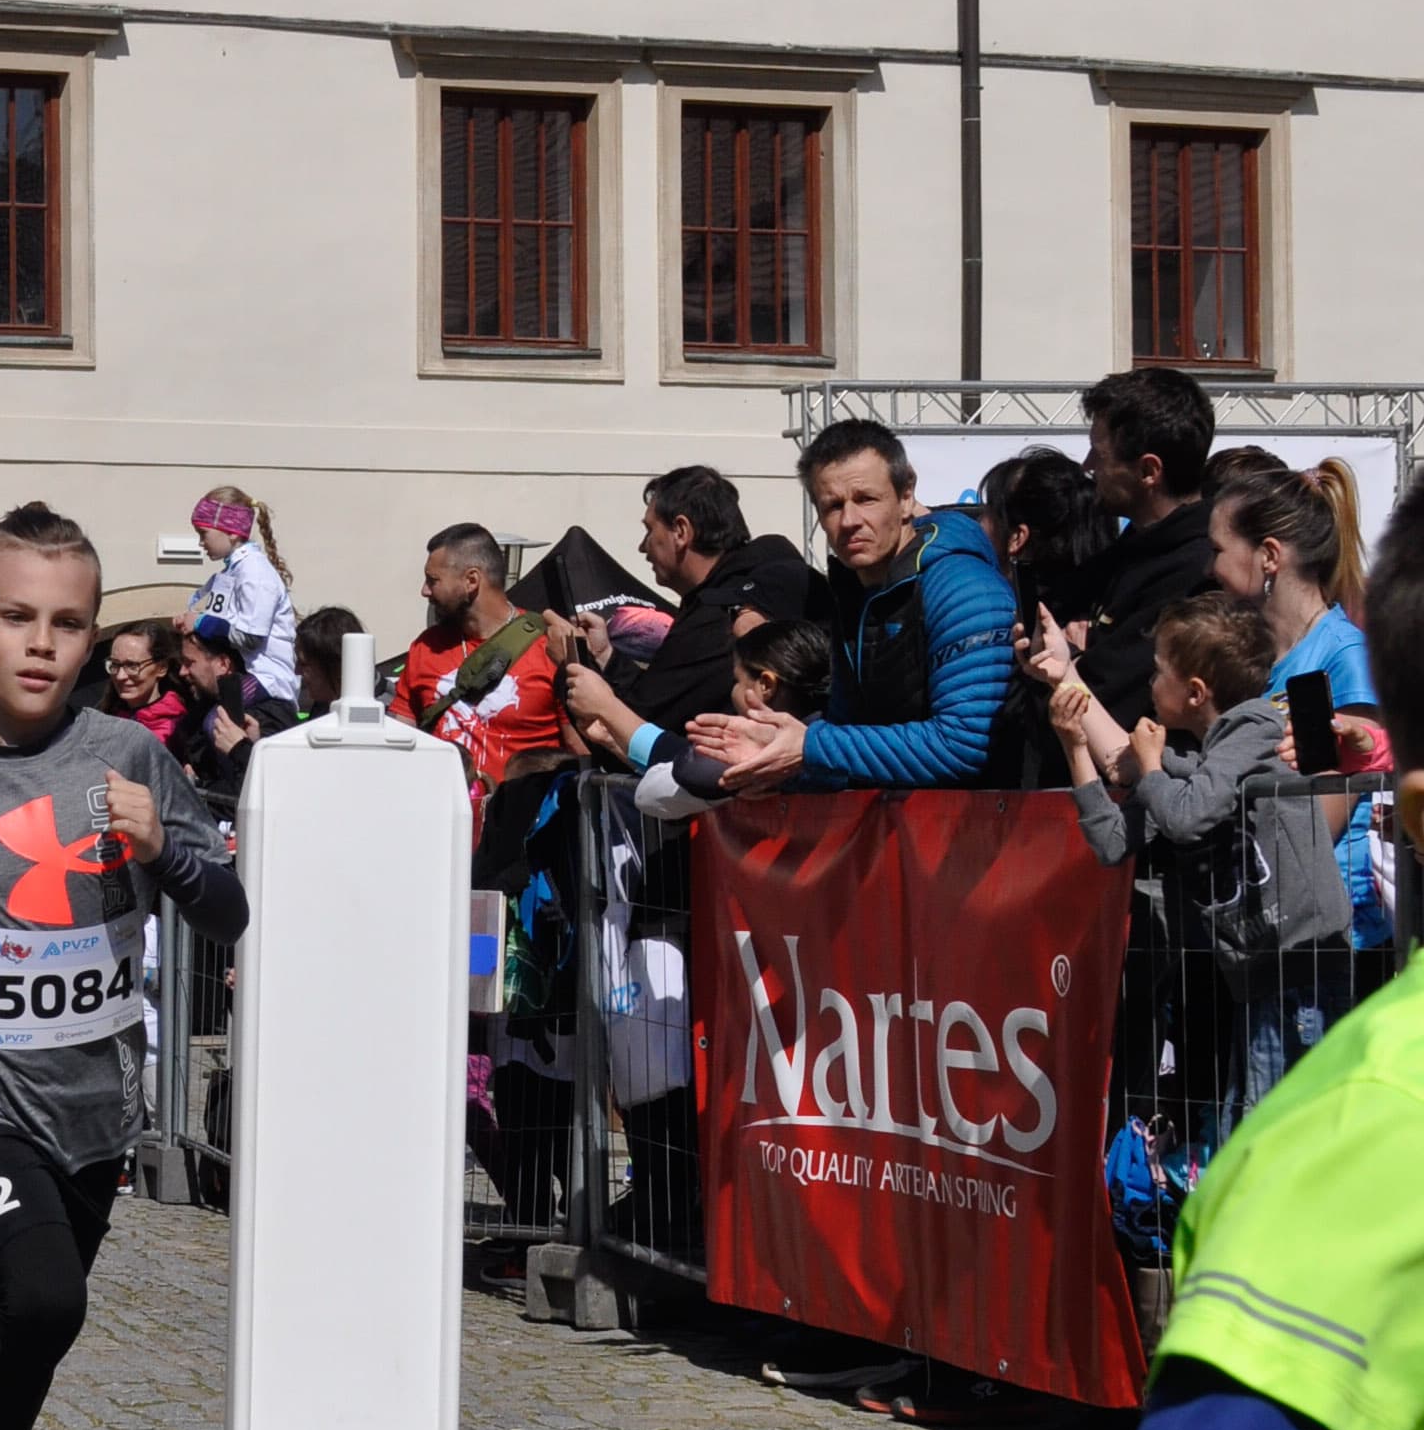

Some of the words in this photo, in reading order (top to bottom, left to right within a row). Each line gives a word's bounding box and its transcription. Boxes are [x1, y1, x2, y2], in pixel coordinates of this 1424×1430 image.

[62, 936, 99, 953] PVZP
[733, 930, 1057, 1154] Nartes
[759, 1140, 787, 1173] TOP
[879, 1160, 954, 1206] ARTEIAN
